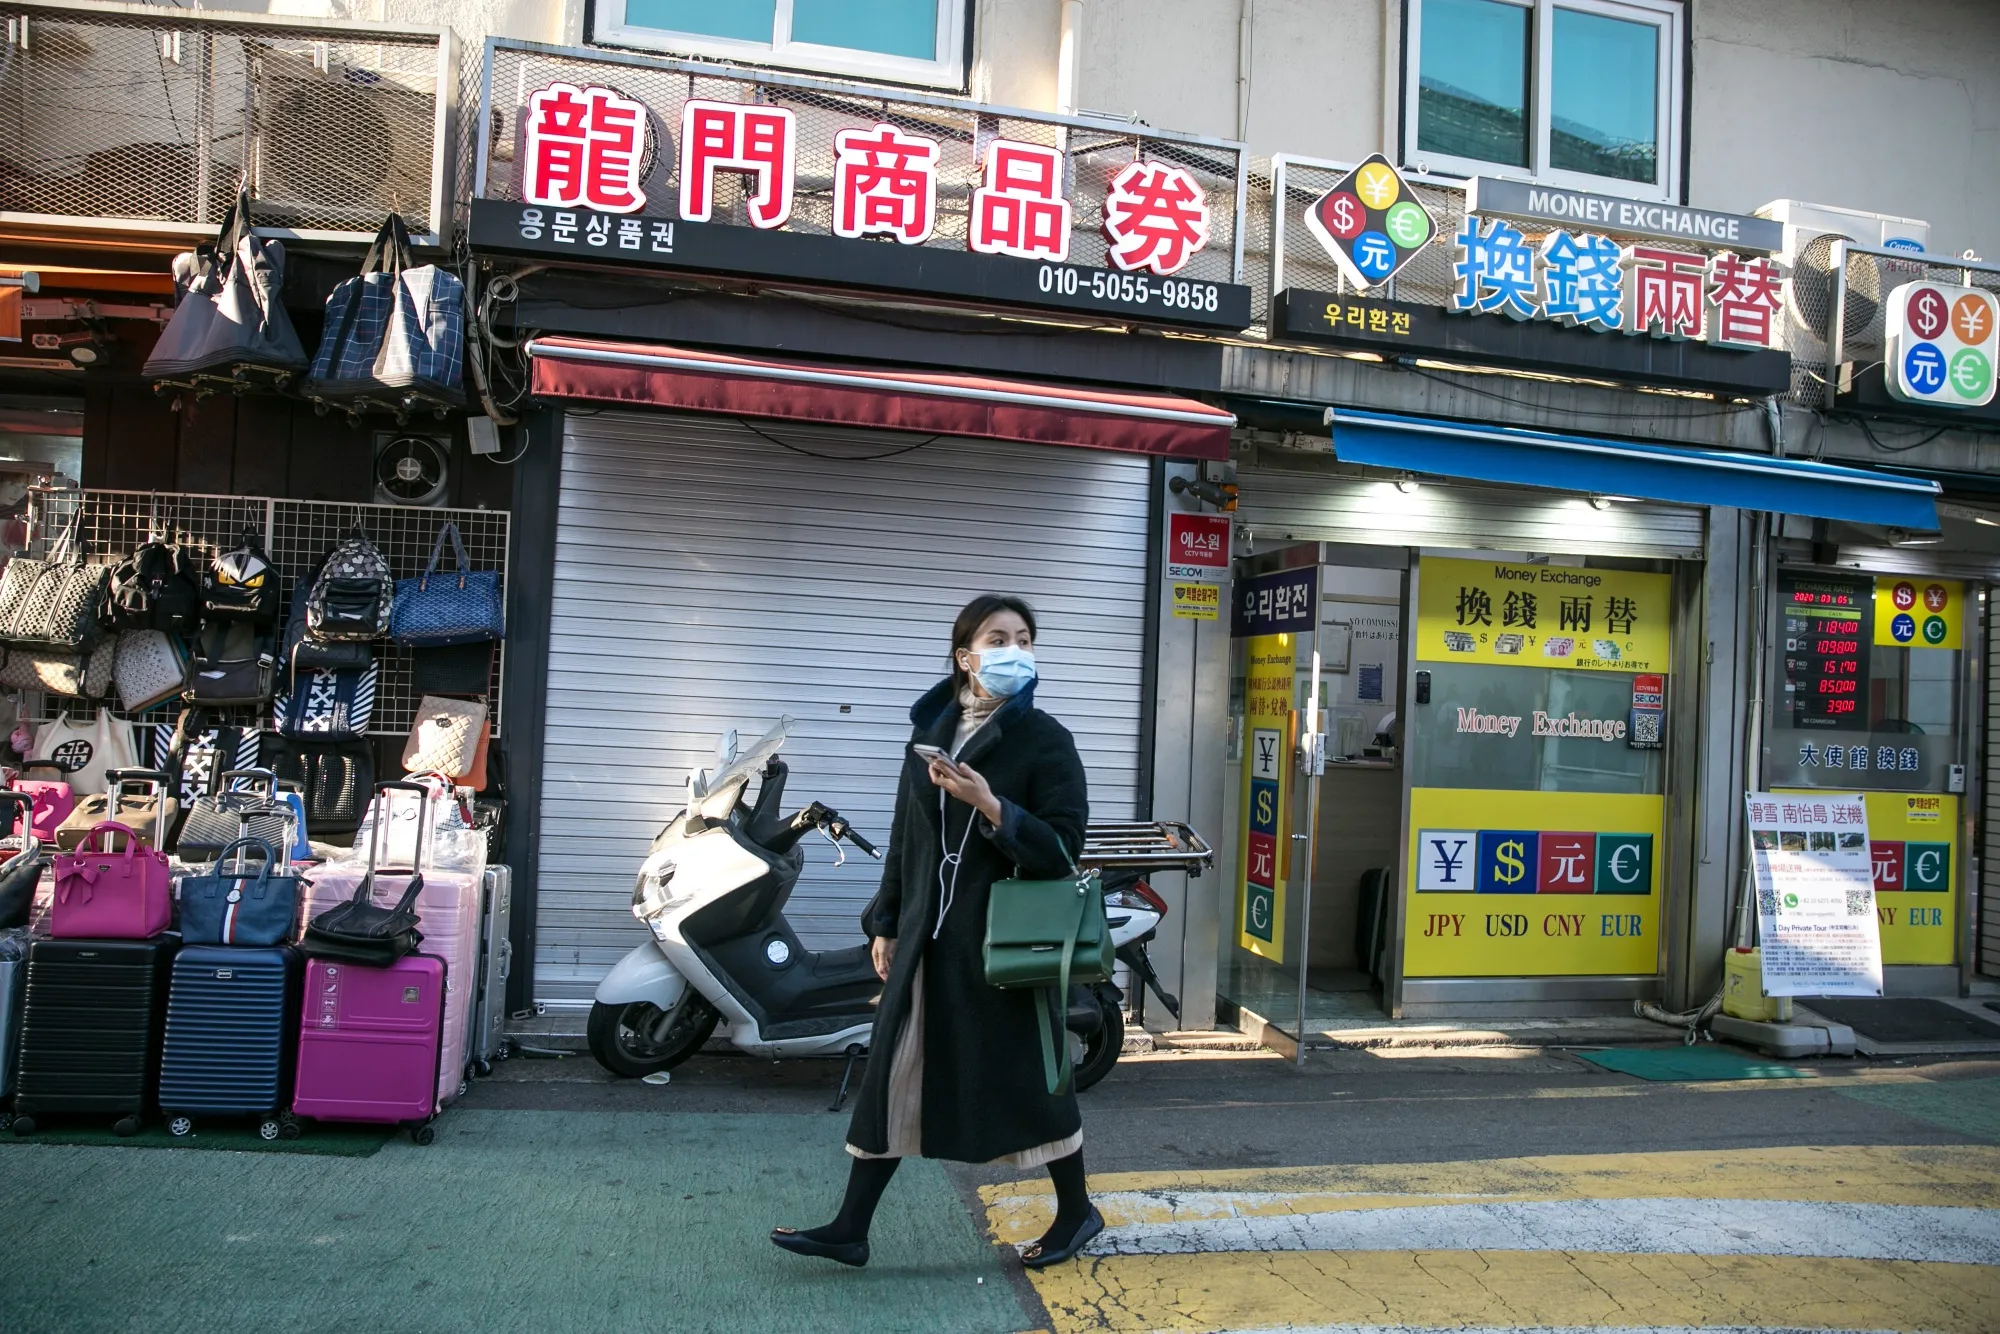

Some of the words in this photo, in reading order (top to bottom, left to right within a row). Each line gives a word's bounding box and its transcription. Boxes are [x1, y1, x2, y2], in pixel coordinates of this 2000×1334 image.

[525, 82, 1209, 275] 龍門商品券
[1365, 171, 1390, 204] ¥
[519, 208, 674, 253] 용문상품권
[1333, 197, 1354, 234] $
[1391, 208, 1421, 241] €
[1528, 190, 1614, 221] MONEY
[1620, 204, 1739, 241] EXCHANGE
[1361, 238, 1389, 270] 元
[1039, 265, 1218, 312] 010-5055-9858
[1323, 304, 1410, 335] 우리환전
[1917, 293, 1938, 335] $
[1960, 302, 1985, 338] ¥
[1911, 351, 1939, 385] 元
[1953, 355, 1981, 390] €
[1180, 531, 1220, 550] 에스원
[1169, 566, 1202, 577] SECOM
[1495, 566, 1537, 584] Money
[1541, 569, 1602, 587] Exchange
[1243, 583, 1308, 623] 우리환전
[1794, 592, 1814, 602] 2020
[1820, 594, 1831, 603] 03
[1837, 595, 1848, 604] 05
[1896, 587, 1912, 605] $
[1927, 589, 1943, 607] ¥
[1349, 617, 1360, 626] NO
[1895, 620, 1912, 636] 元
[1926, 621, 1942, 638] €
[1479, 633, 1488, 643] $
[1250, 655, 1266, 667] Money
[1267, 654, 1291, 665] Exchange
[1635, 694, 1661, 703] SECOM
[1457, 708, 1522, 738] Money
[1532, 711, 1626, 742] Exchange
[1258, 737, 1275, 772] ¥
[1798, 743, 1868, 769] 大使館
[1257, 788, 1272, 826] $
[1749, 803, 1778, 823] 滑雪
[1781, 803, 1828, 824] 南怡島
[1832, 803, 1864, 825] 送機
[1253, 844, 1271, 878] 元
[1431, 840, 1467, 882] ¥
[1494, 839, 1525, 885] $
[1549, 842, 1585, 883] 元
[1608, 844, 1640, 883] €
[1872, 850, 1897, 882] 元
[1914, 851, 1940, 882] €
[1251, 895, 1268, 929] €
[1424, 914, 1466, 937] JPY
[1485, 914, 1528, 937] USD
[1543, 914, 1586, 937] CNY
[1601, 914, 1642, 937] EUR
[1909, 908, 1942, 926] EUR
